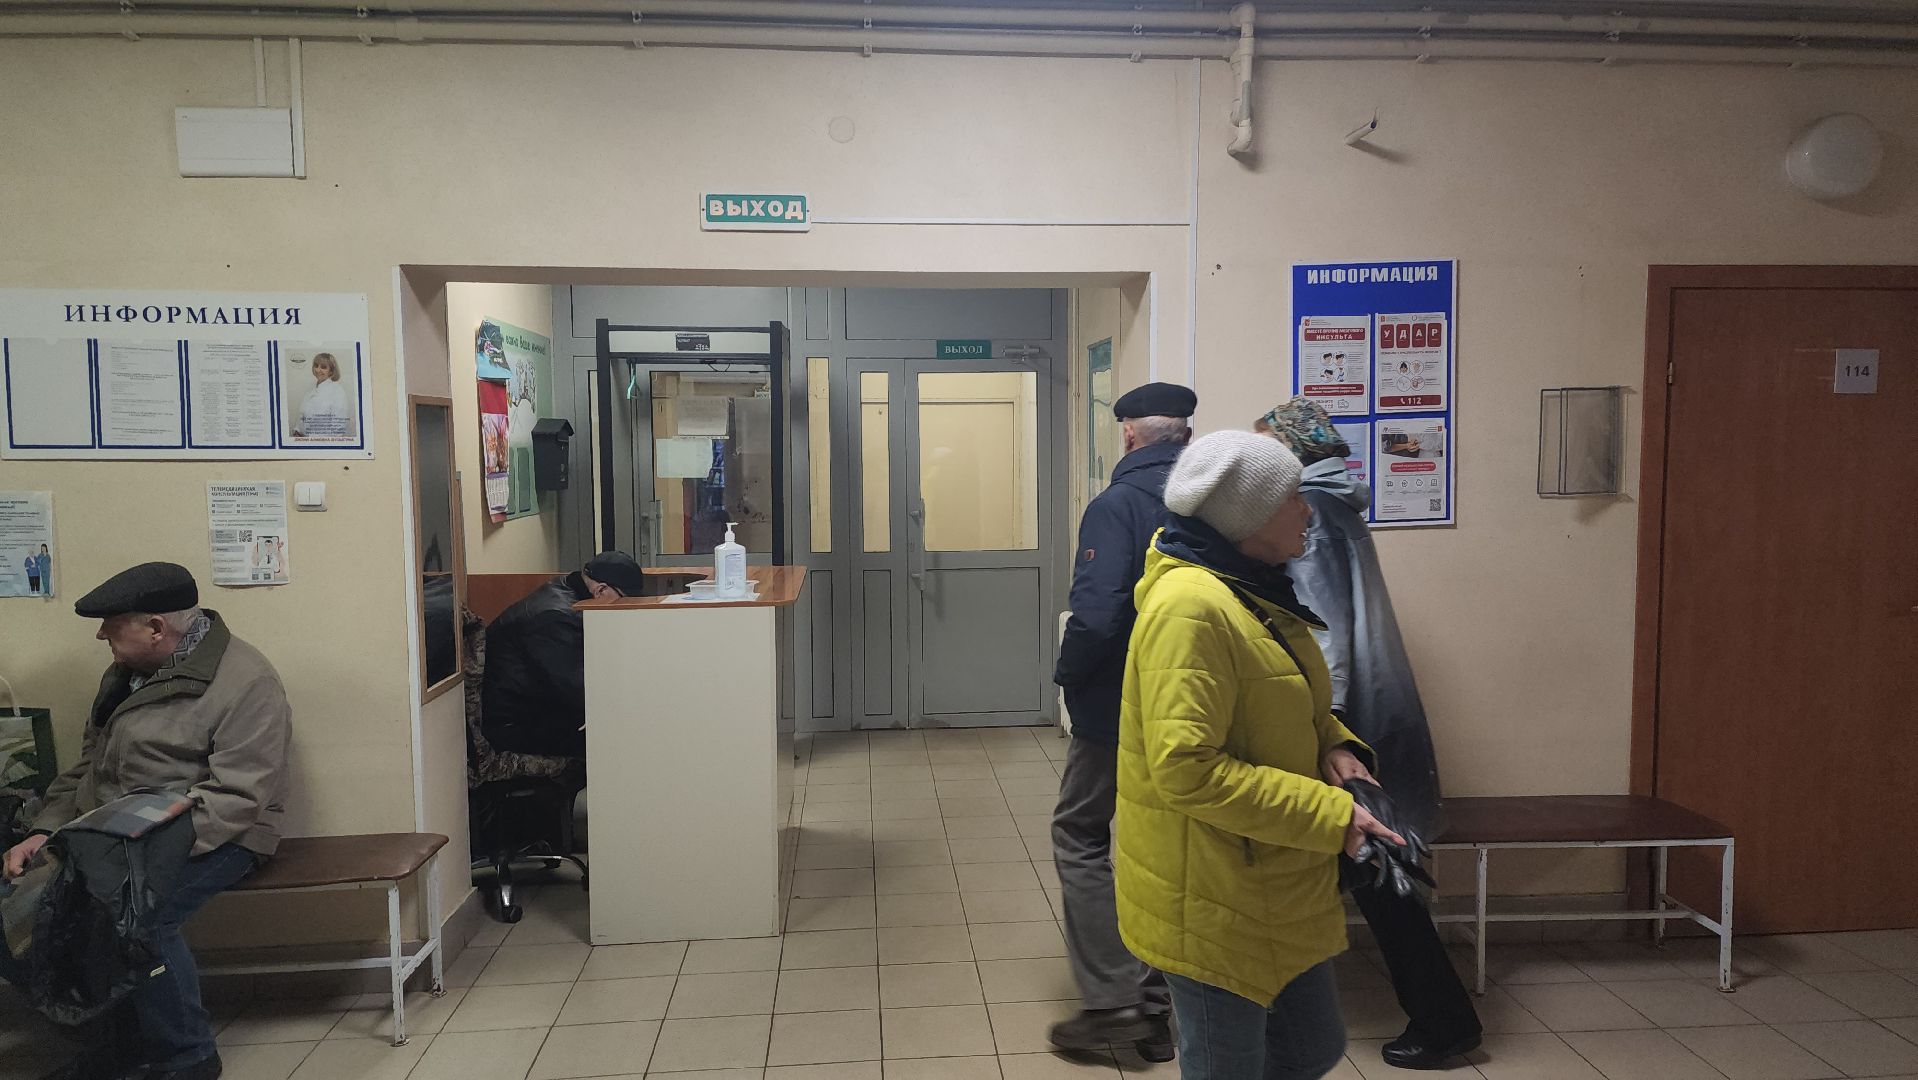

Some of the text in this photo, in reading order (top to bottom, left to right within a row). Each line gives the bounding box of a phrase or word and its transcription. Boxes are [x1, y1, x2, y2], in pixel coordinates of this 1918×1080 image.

[709, 200, 804, 220] ВЫХОД
[1307, 266, 1438, 284] ИНФОРМАЦИЯ
[64, 304, 302, 327] ИНФОРМАЦИЯ
[944, 344, 984, 355] ВЫХОД
[1845, 365, 1870, 377] 114
[1407, 397, 1422, 405] 112
